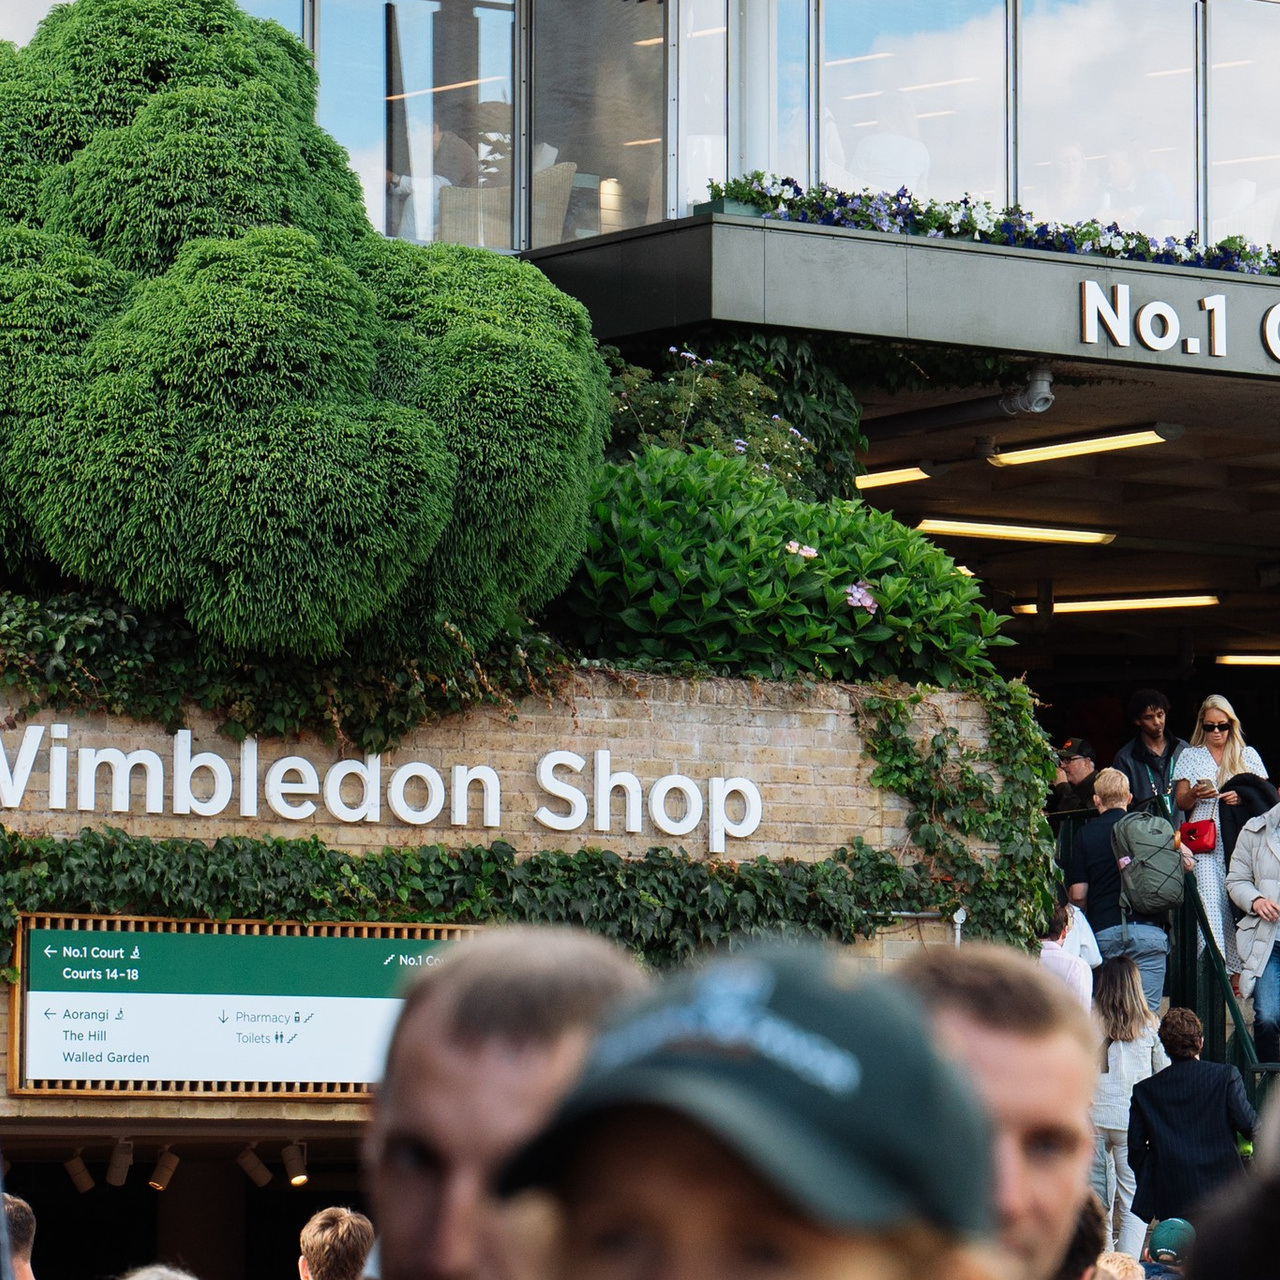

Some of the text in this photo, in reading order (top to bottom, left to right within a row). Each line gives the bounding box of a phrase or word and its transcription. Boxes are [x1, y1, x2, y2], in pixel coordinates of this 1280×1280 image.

[1080, 279, 1227, 357] No.1
[533, 749, 763, 853] Shop
[62, 946, 125, 959] No.1 Court
[399, 954, 423, 966] No.1
[62, 967, 103, 980] Courts
[62, 1008, 109, 1022] Aorangi
[235, 1011, 292, 1026] Pharmacy
[62, 1029, 107, 1042] The Hill
[235, 1032, 271, 1045] Toilets
[62, 1051, 150, 1064] Walled Garden
